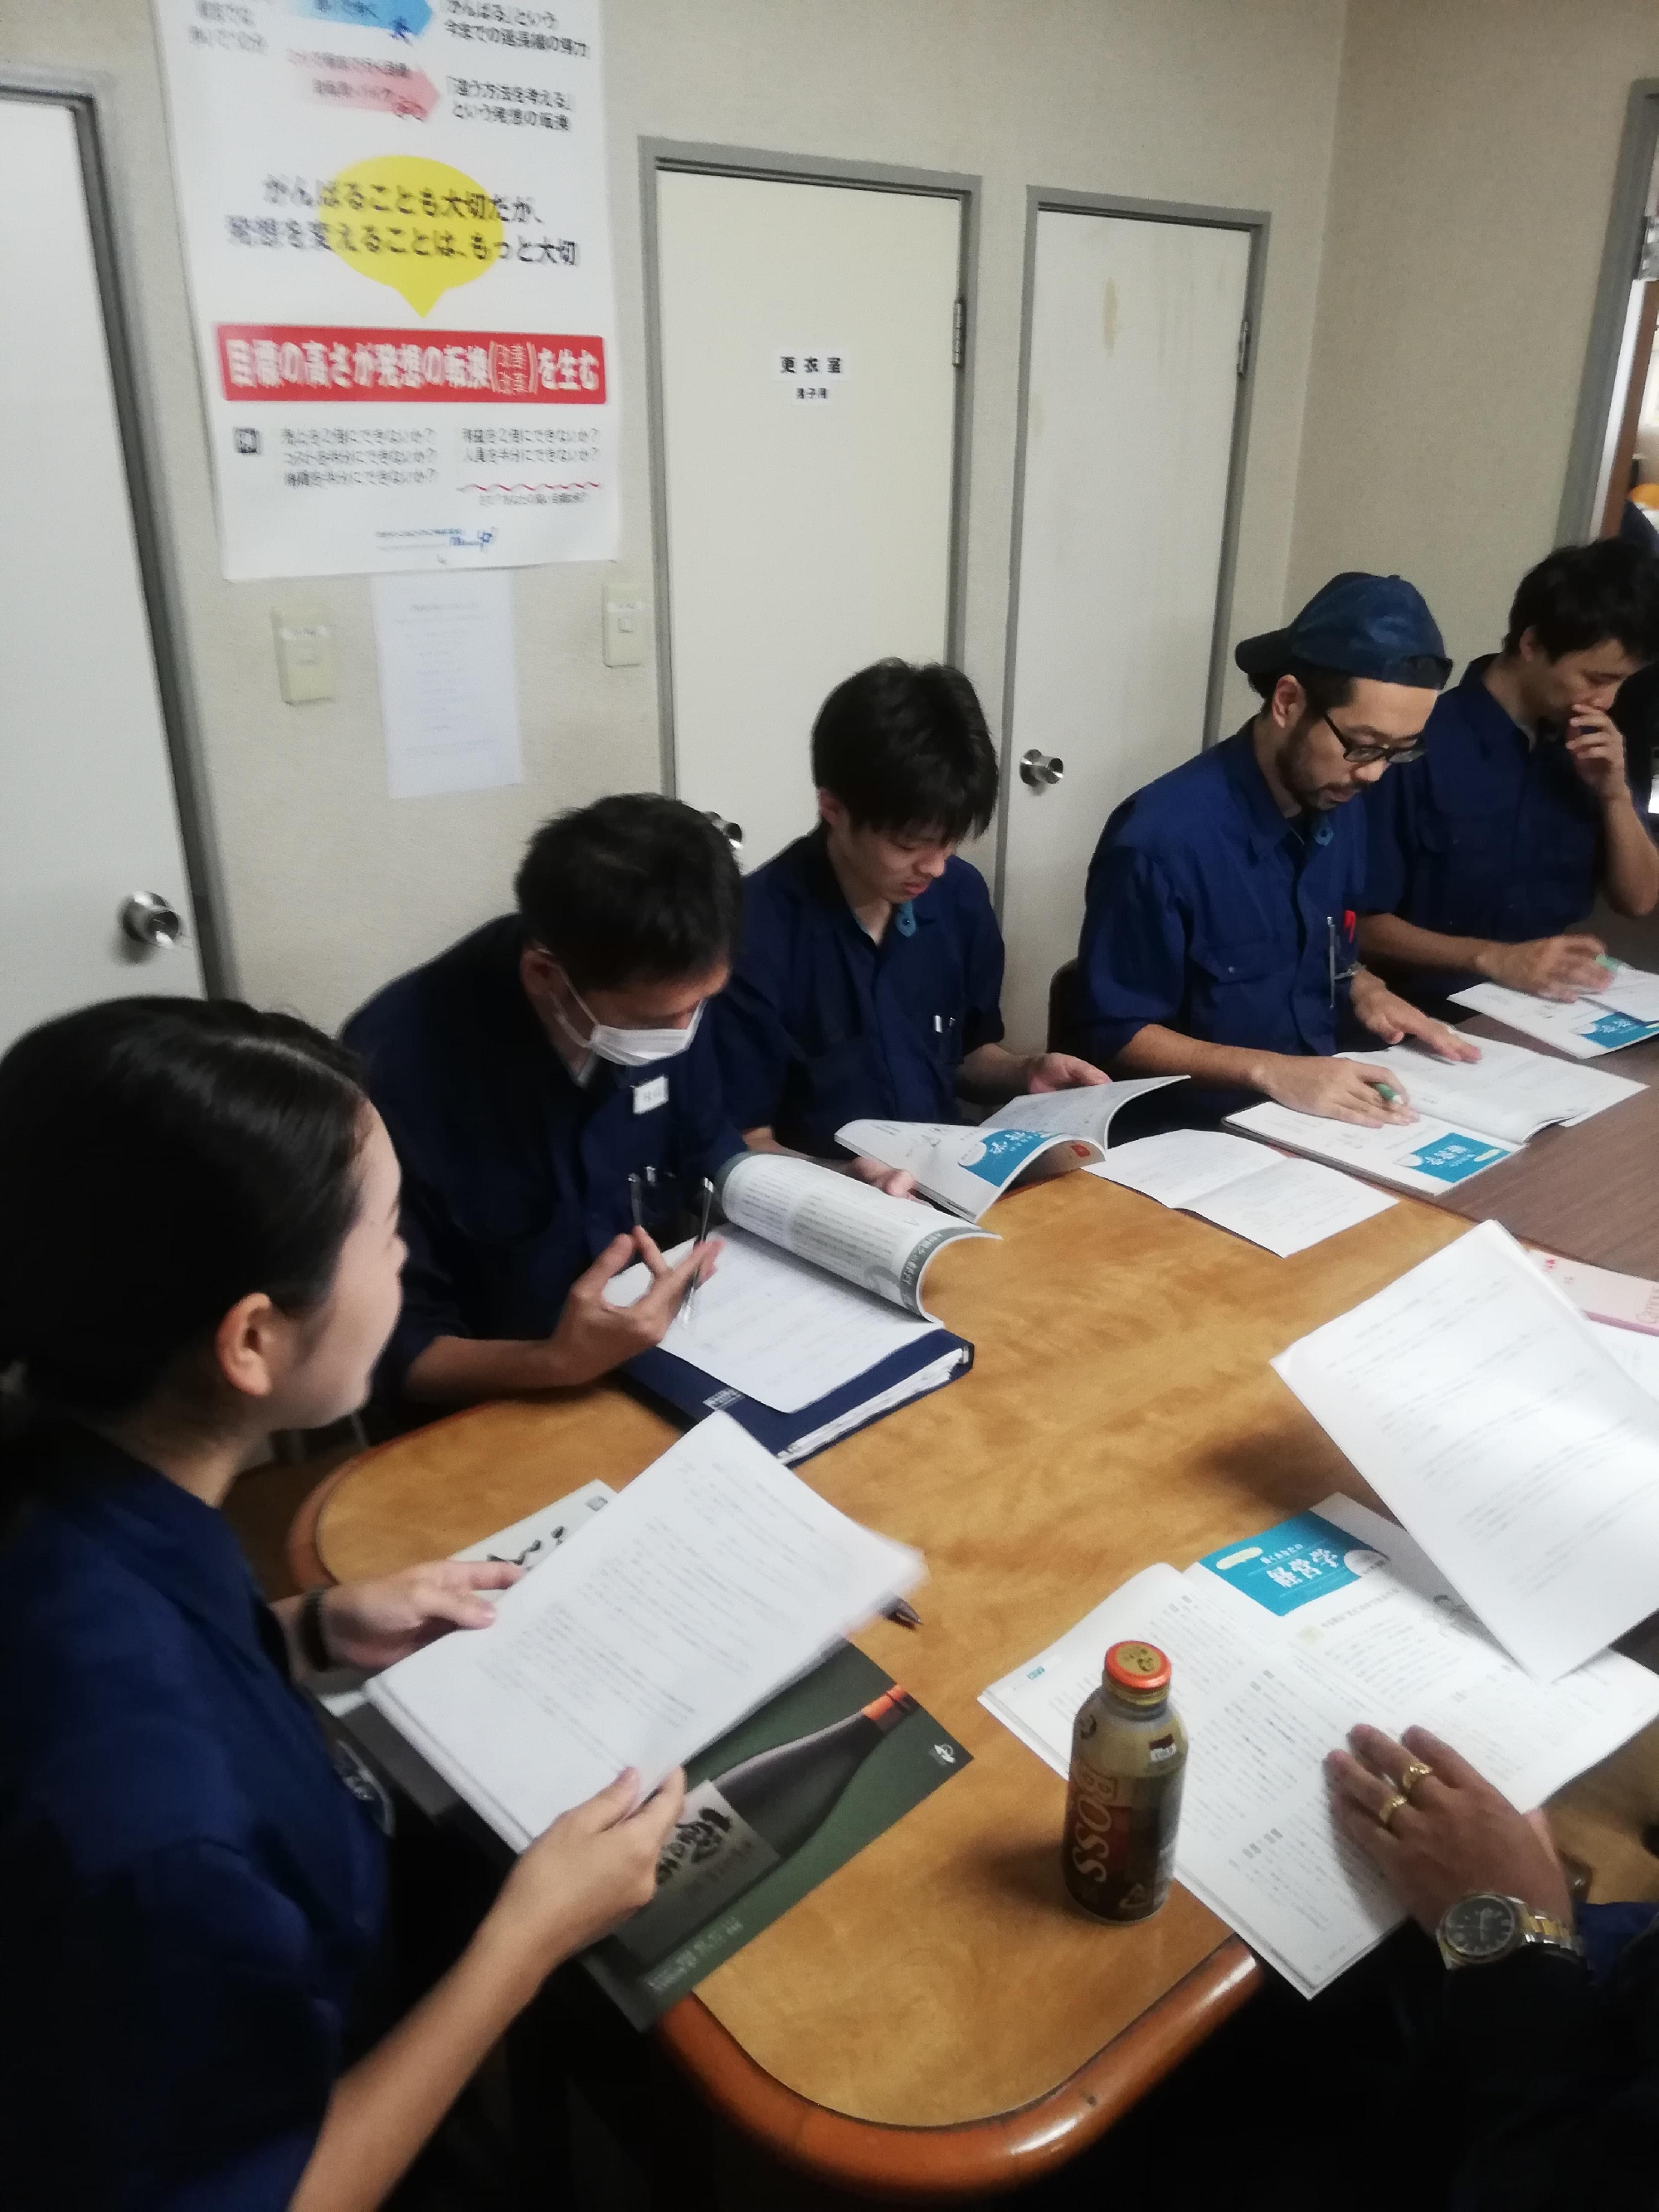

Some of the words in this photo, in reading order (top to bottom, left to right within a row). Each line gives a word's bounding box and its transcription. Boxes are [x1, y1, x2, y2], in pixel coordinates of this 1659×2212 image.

[260, 173, 544, 226] がんばることも大切だが、
[780, 356, 842, 374] 更衣室
[1266, 1547, 1340, 1588] 経営学
[1072, 1761, 1118, 1883] BOSS
